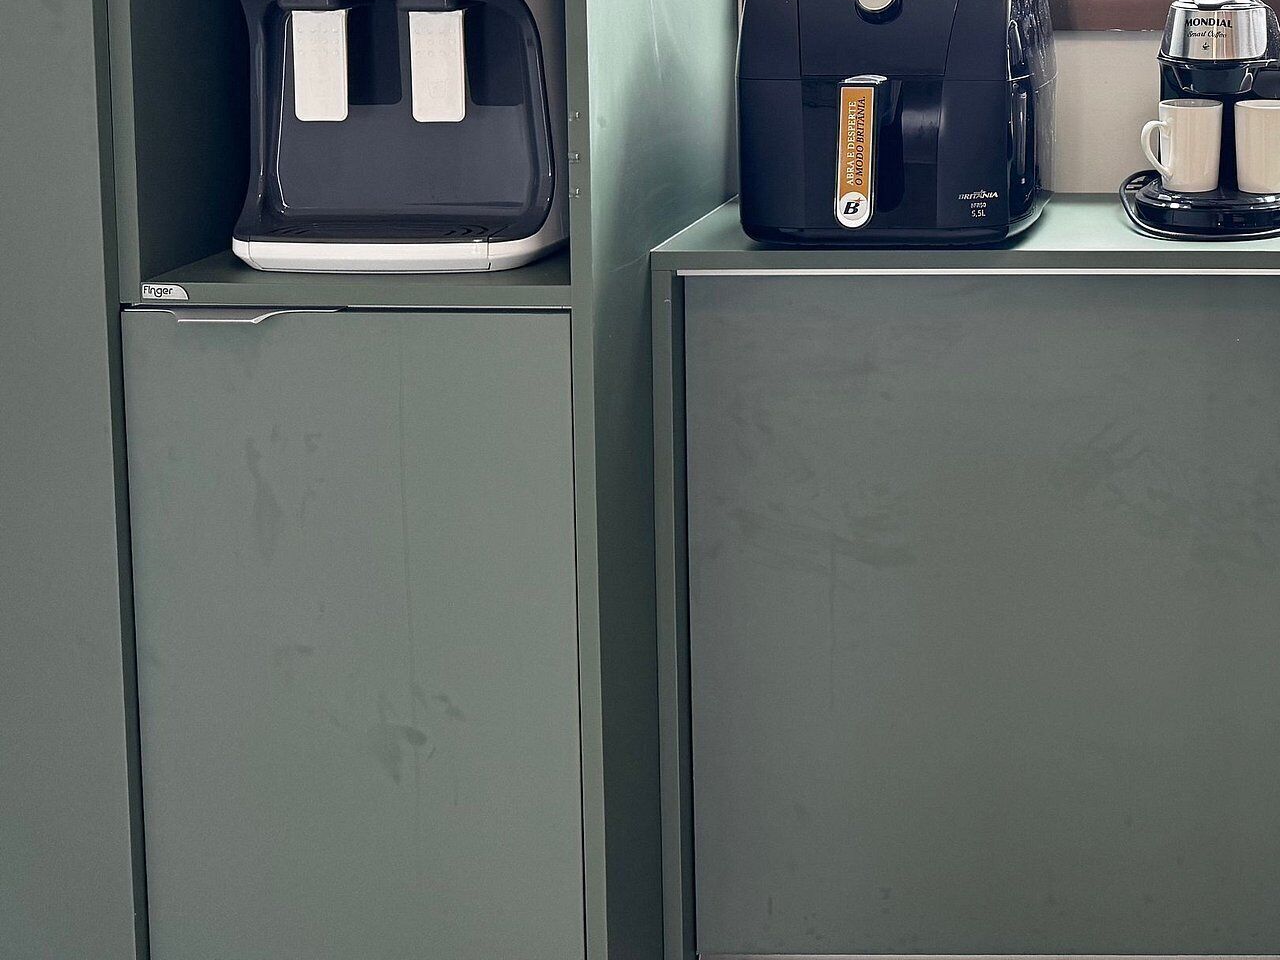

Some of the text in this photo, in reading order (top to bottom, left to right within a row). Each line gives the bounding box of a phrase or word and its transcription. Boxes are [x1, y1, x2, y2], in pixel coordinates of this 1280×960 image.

[1185, 17, 1232, 28] MONDIAL
[846, 101, 857, 185] ABRA E DESPERTE
[855, 146, 864, 177] MODO
[143, 285, 173, 298] Finger
